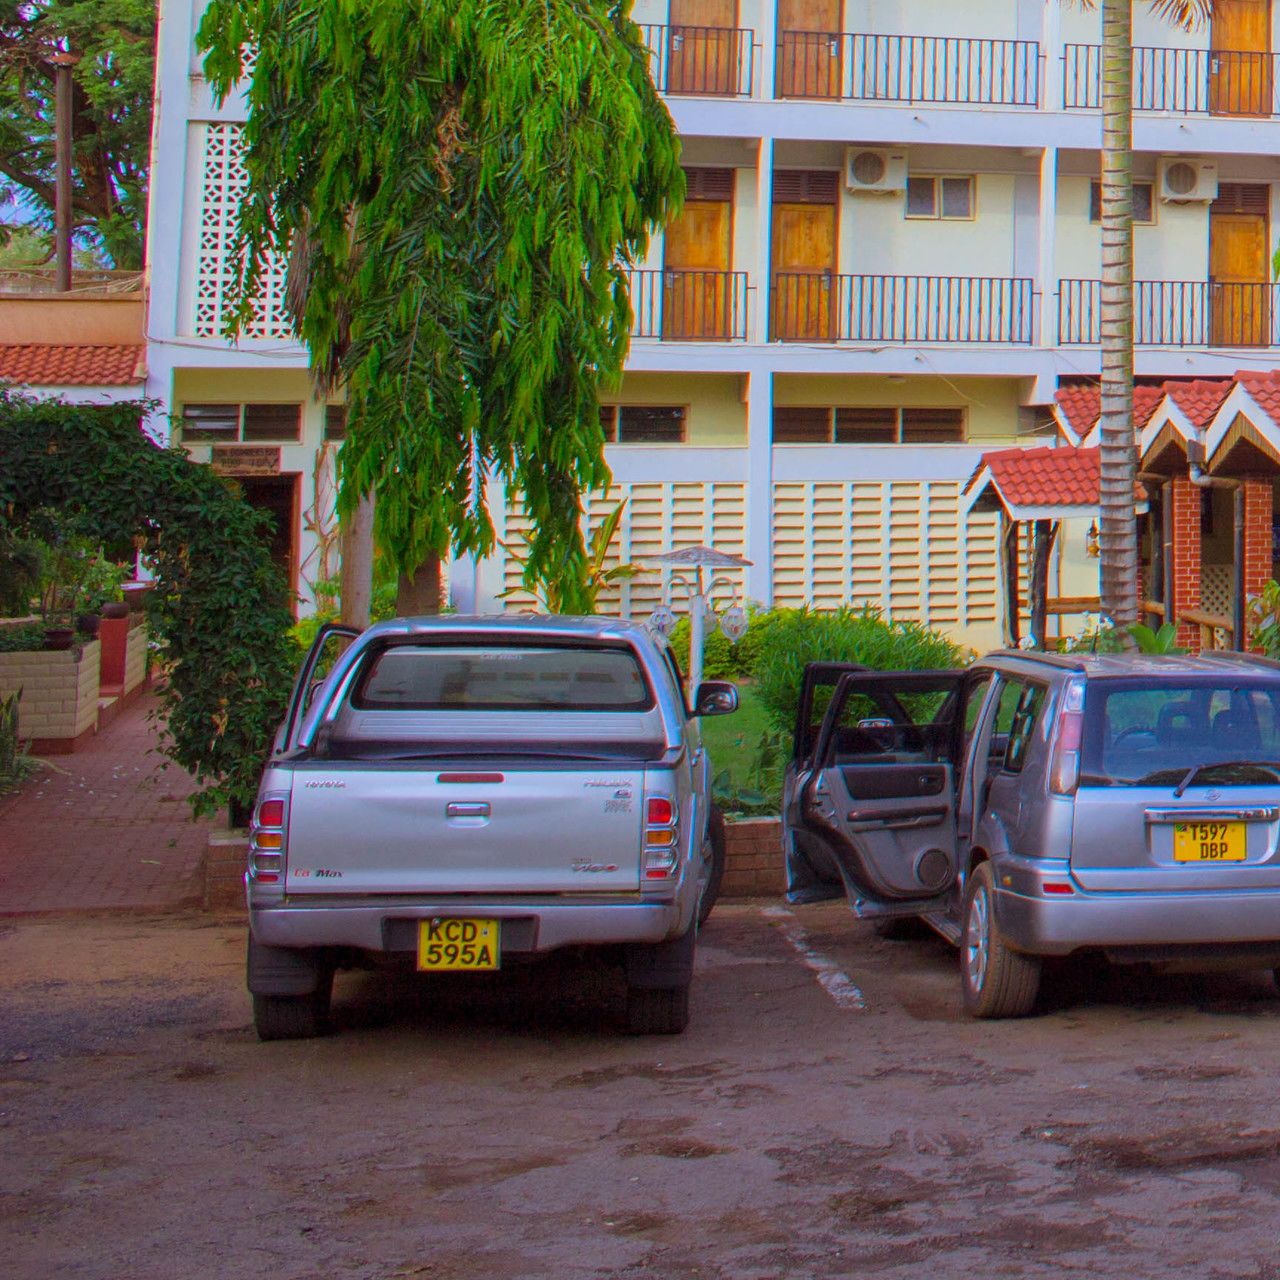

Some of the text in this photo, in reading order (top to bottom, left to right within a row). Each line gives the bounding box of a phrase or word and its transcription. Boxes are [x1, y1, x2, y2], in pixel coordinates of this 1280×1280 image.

[1190, 823, 1228, 841] T597
[1200, 842, 1228, 858] DBP
[428, 920, 478, 942] KCD
[426, 943, 492, 965] 595A
